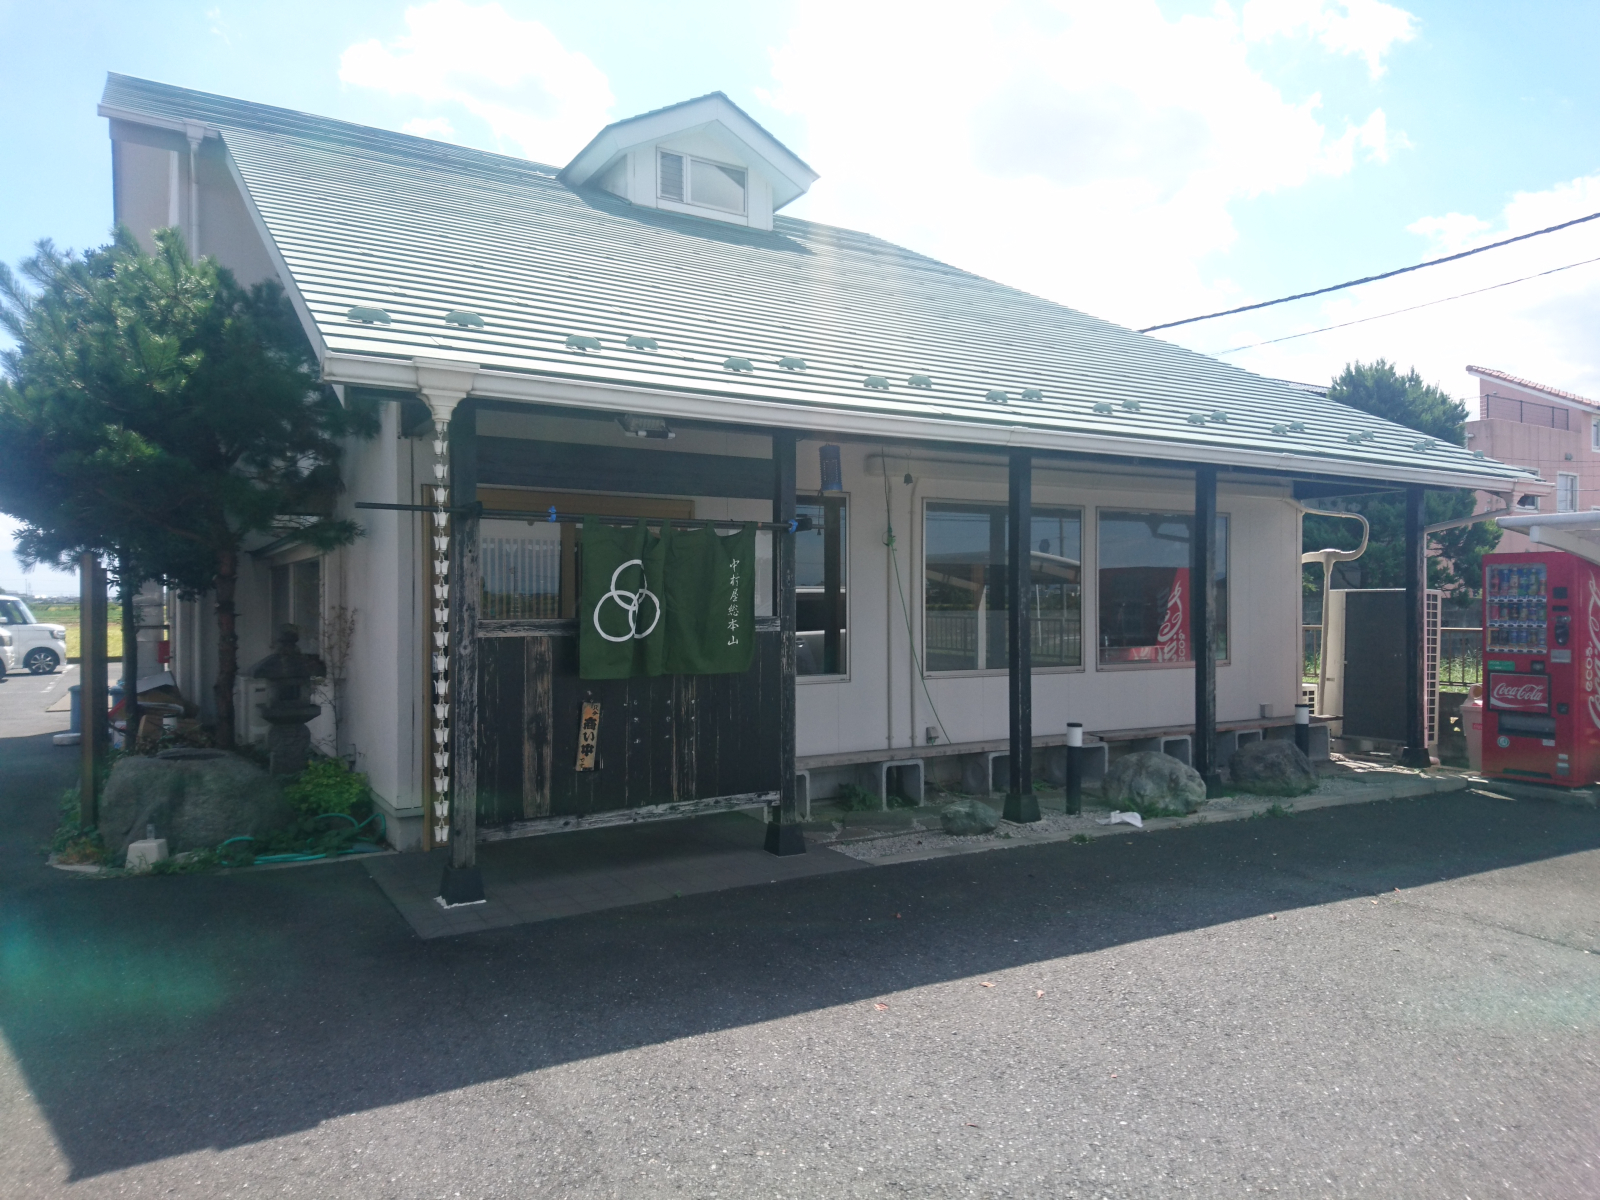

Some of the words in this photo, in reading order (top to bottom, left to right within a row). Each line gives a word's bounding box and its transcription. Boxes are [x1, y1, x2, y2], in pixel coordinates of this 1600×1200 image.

[727, 558, 741, 646] 中村屋総本山
[1493, 683, 1544, 700] Coca-Cola
